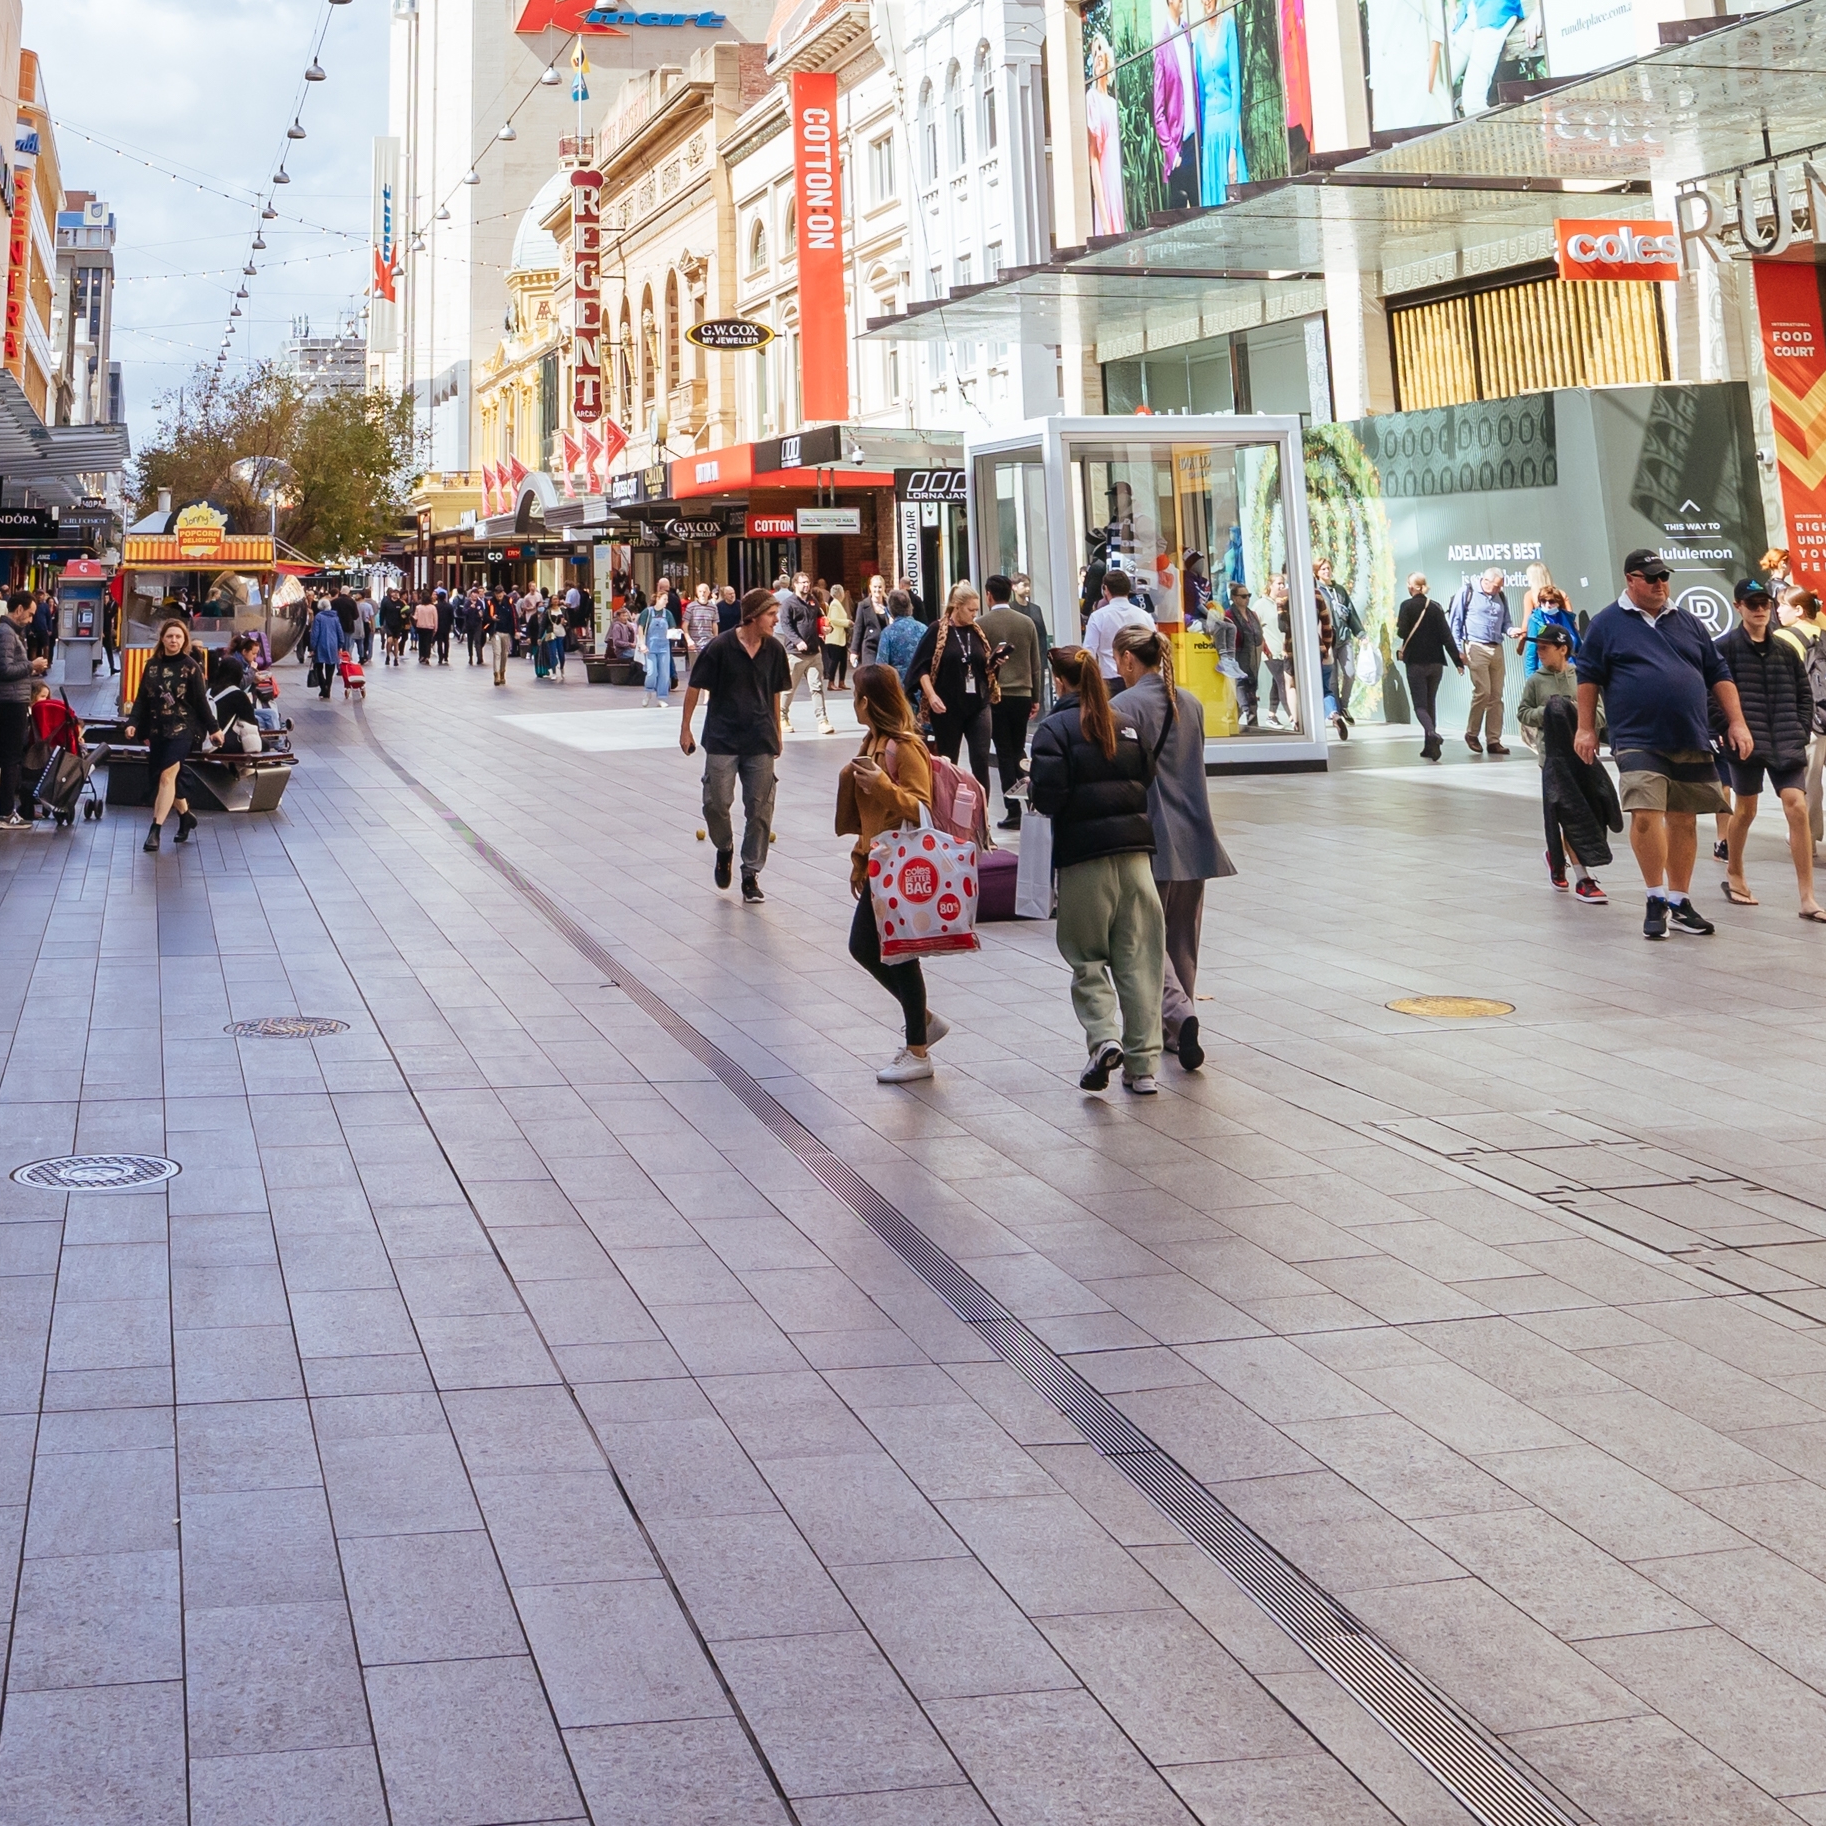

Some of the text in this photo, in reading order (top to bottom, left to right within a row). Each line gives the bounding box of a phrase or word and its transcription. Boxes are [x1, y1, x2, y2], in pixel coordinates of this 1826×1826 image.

[1567, 226, 1682, 264] coles
[575, 185, 602, 407] REGENT
[1772, 331, 1813, 342] FOOD
[1773, 346, 1816, 357] COURT
[906, 492, 945, 500] LORNA
[754, 520, 794, 533] COTTON
[906, 510, 917, 539] HAIR
[1664, 523, 1721, 531] THIS WAY TO
[179, 530, 220, 539] POPCORN
[182, 537, 217, 545] DELIGHTS
[1447, 543, 1541, 562] ADELAIDE'S BEST
[1659, 546, 1733, 561] lululemon
[1503, 569, 1531, 587] bette
[905, 865, 931, 876] coles
[905, 882, 932, 895] BAG
